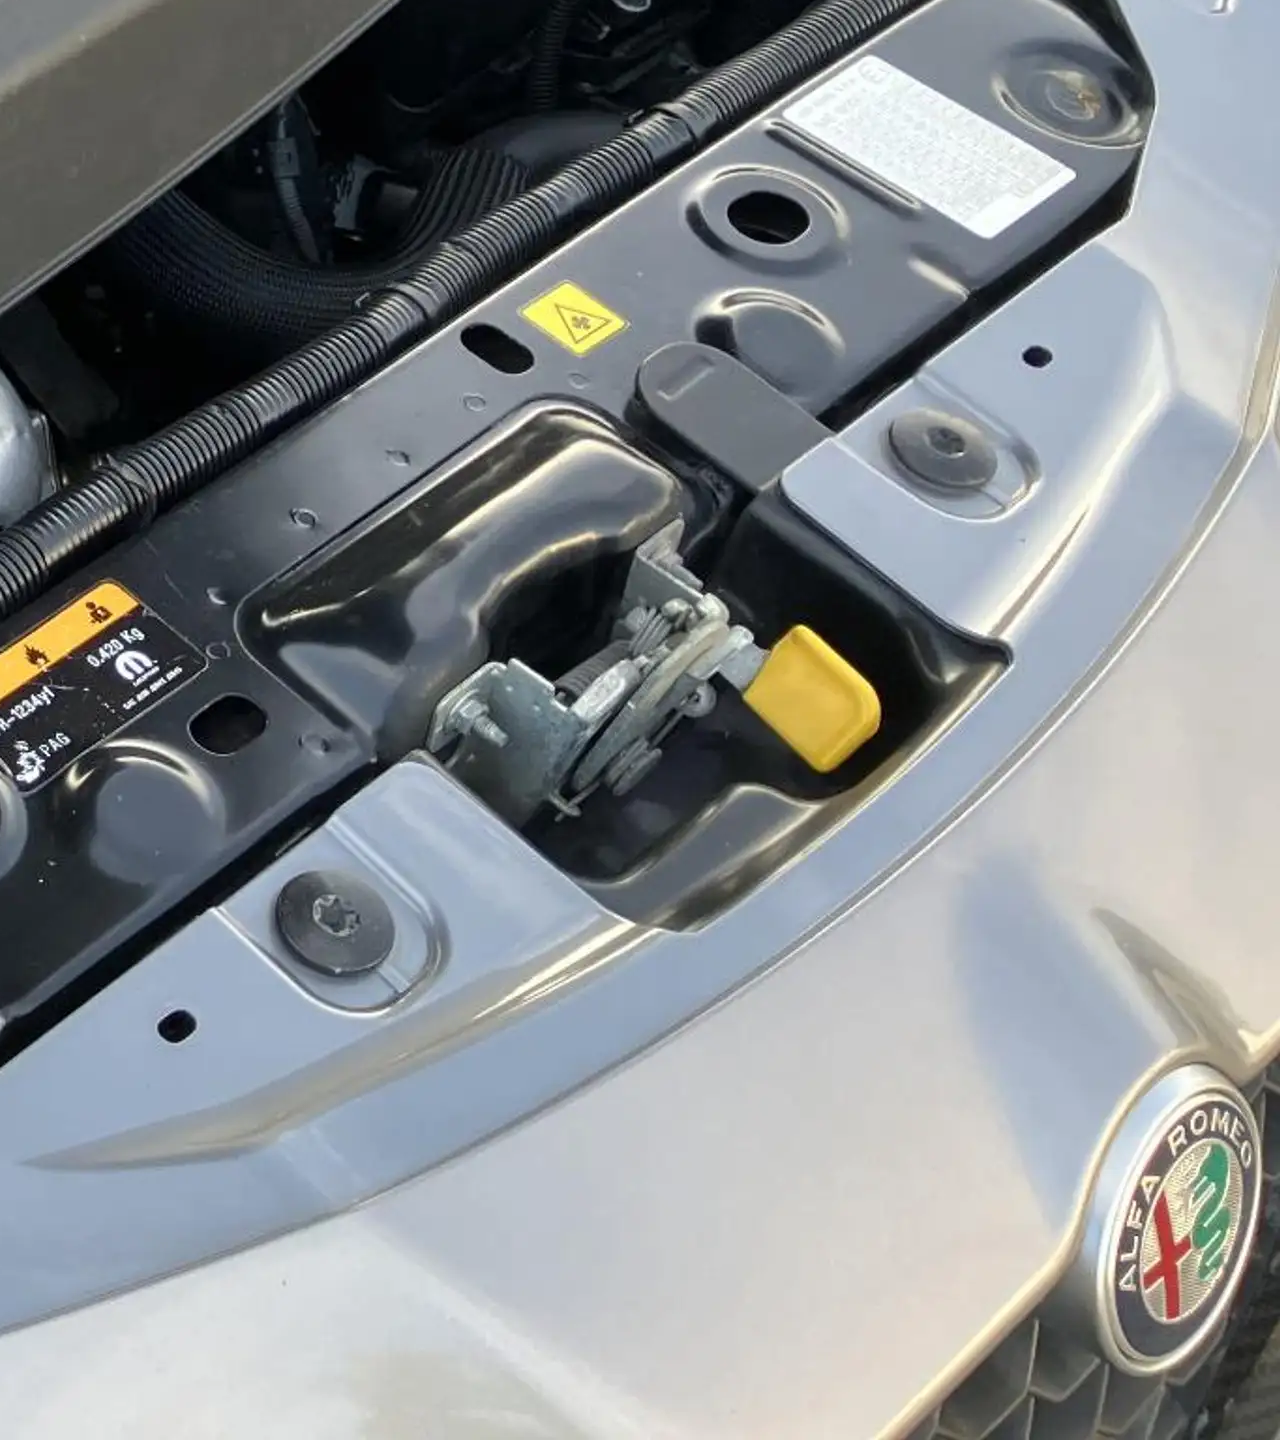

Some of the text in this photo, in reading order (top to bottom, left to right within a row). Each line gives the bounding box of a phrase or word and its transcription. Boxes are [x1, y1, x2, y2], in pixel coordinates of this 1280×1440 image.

[87, 626, 145, 668] 0.420 Kg
[40, 732, 72, 759] PAG
[1120, 1107, 1253, 1292] ALFA ROMEO
